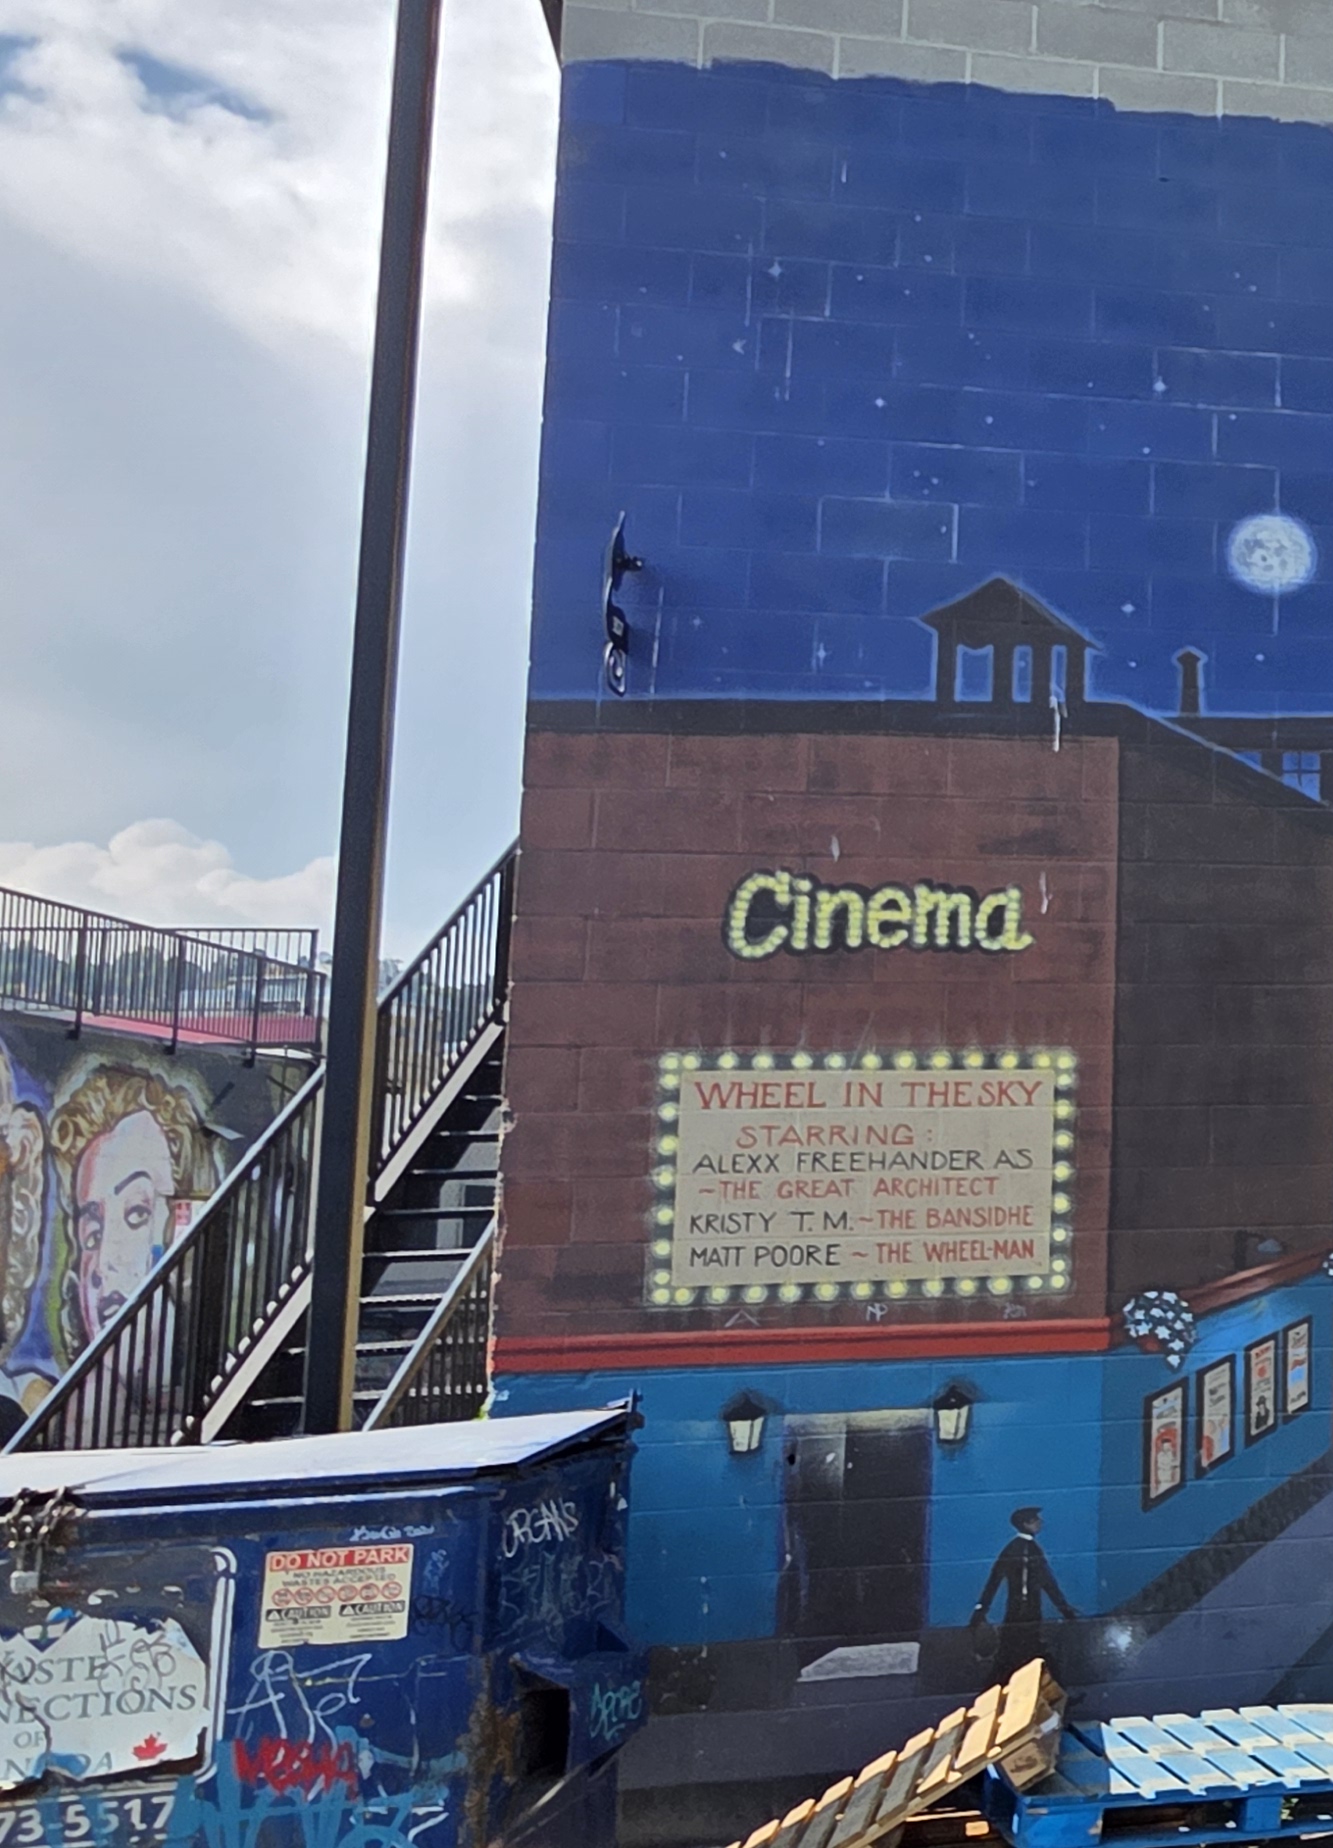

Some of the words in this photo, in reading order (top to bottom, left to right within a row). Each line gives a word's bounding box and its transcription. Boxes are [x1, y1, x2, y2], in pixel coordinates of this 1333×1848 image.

[728, 870, 1034, 959] Cinema
[694, 1081, 827, 1110] WHEEL
[843, 1081, 883, 1108] IN
[901, 1080, 973, 1108] THE
[977, 1080, 1043, 1108] SKY
[692, 1153, 780, 1174] ALEXX
[797, 1150, 985, 1173] FREEHANDER
[993, 1149, 1033, 1170] AS
[776, 1178, 855, 1200] GREAT
[873, 1176, 999, 1199] ARCHITECT
[689, 1211, 777, 1235] KRISTY
[926, 1205, 1034, 1229] BANSIDHE
[689, 1246, 747, 1267] MATT
[754, 1243, 842, 1268] POORE
[876, 1241, 913, 1265] THE
[923, 1239, 1034, 1263] WHEEL-MAN
[272, 1554, 301, 1570] DO
[306, 1551, 350, 1568] NOT
[354, 1548, 409, 1564] PARK
[281, 1606, 331, 1620] CAUTION
[355, 1600, 405, 1615] CAUTION
